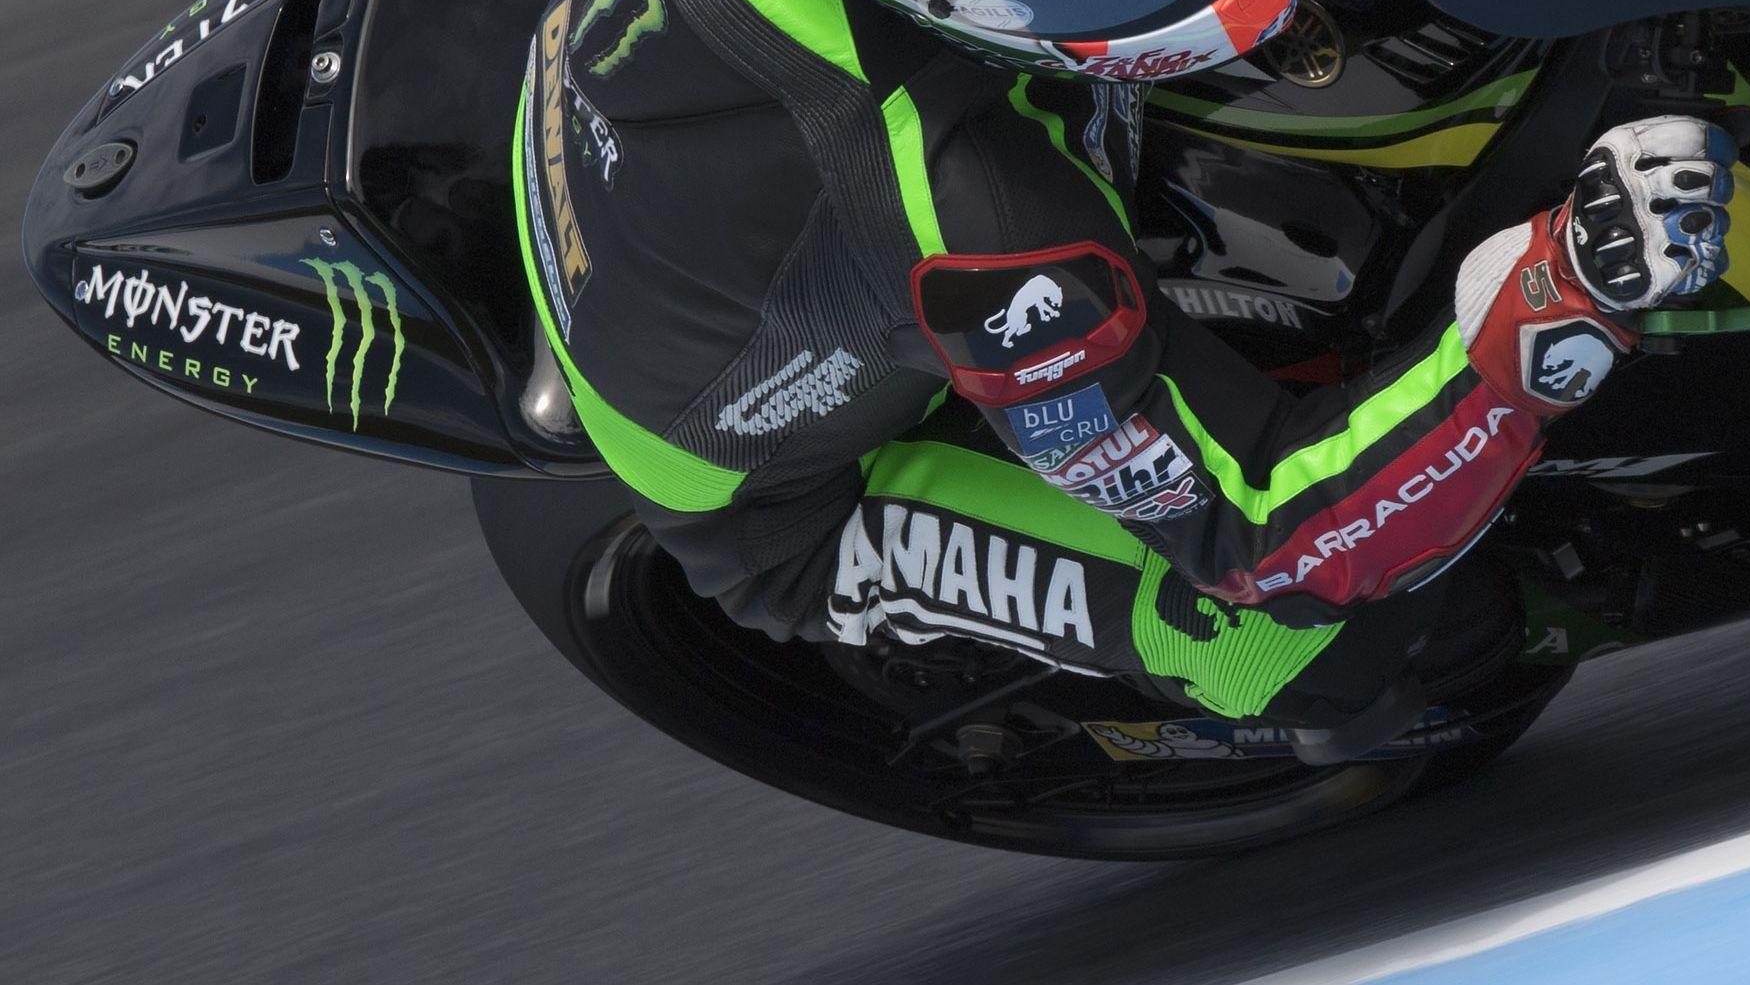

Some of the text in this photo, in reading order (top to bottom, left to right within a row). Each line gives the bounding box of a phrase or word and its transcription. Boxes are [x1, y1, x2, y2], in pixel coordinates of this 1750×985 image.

[84, 265, 301, 371] MONSTER
[1519, 259, 1563, 312] 5
[107, 333, 258, 394] ENERGY
[1254, 406, 1514, 594] BARRACUDA
[834, 502, 1096, 650] AMAHA
